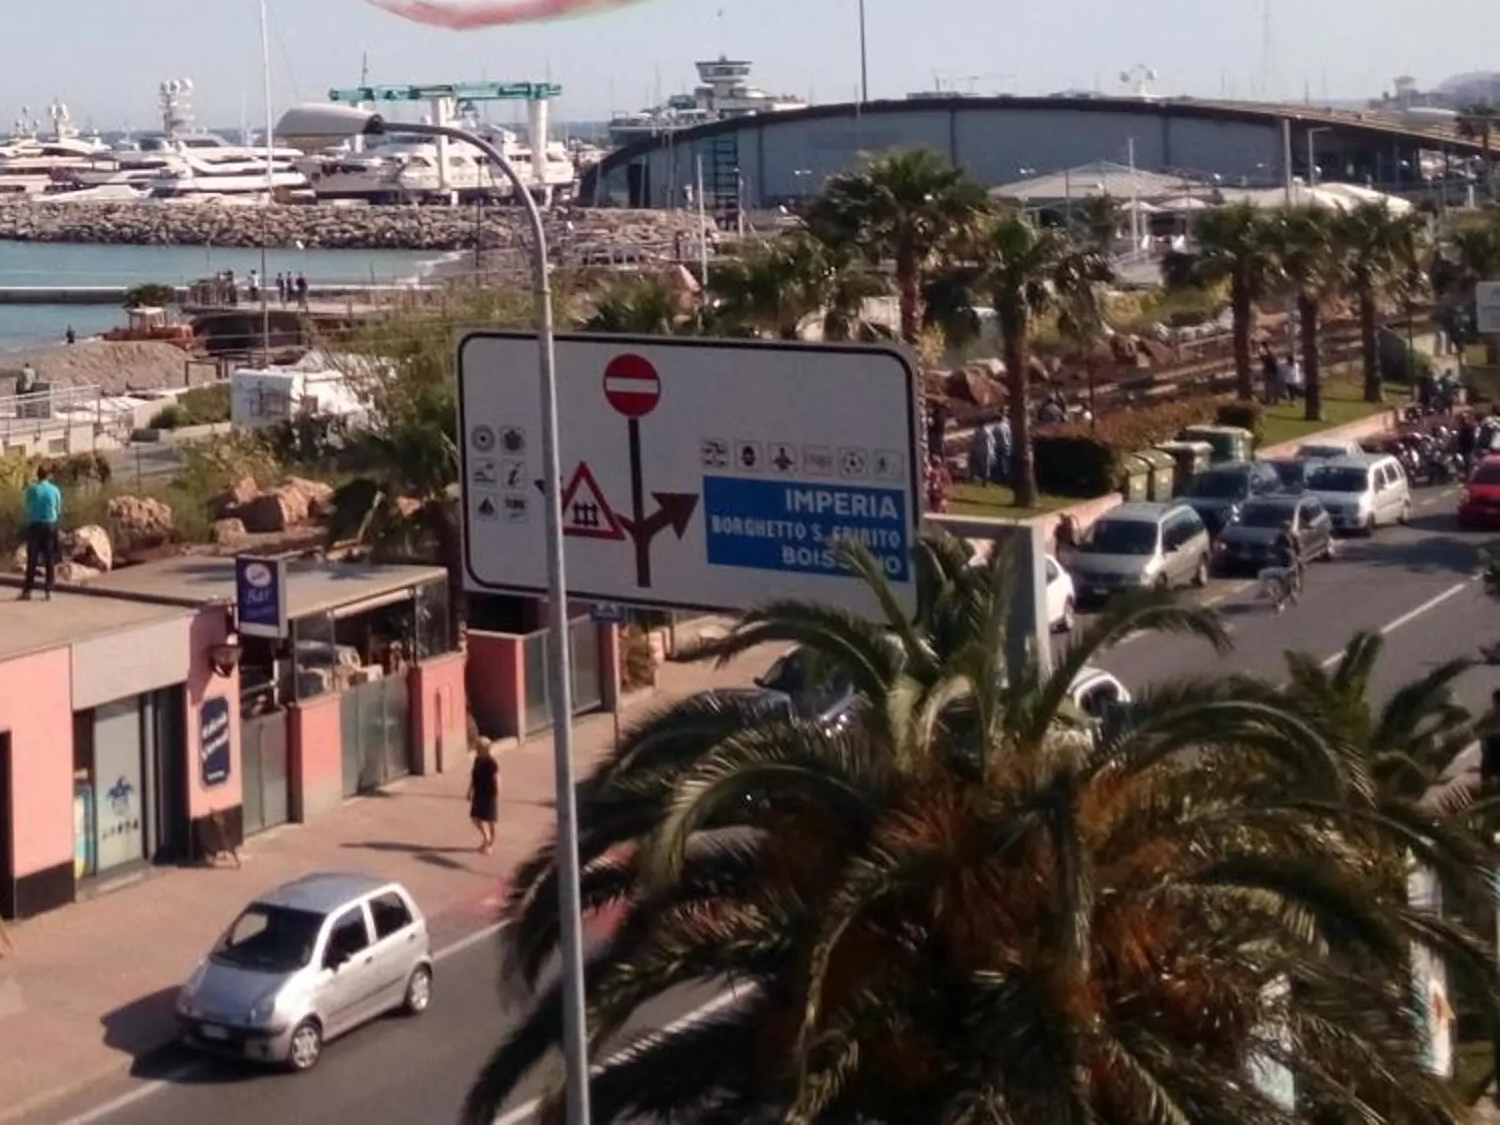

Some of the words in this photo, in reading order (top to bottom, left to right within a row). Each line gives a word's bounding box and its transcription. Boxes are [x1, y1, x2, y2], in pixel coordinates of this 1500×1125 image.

[785, 488, 899, 520] IMPERIA
[711, 515, 807, 541] BORGHETTO
[781, 546, 901, 574] BOISO
